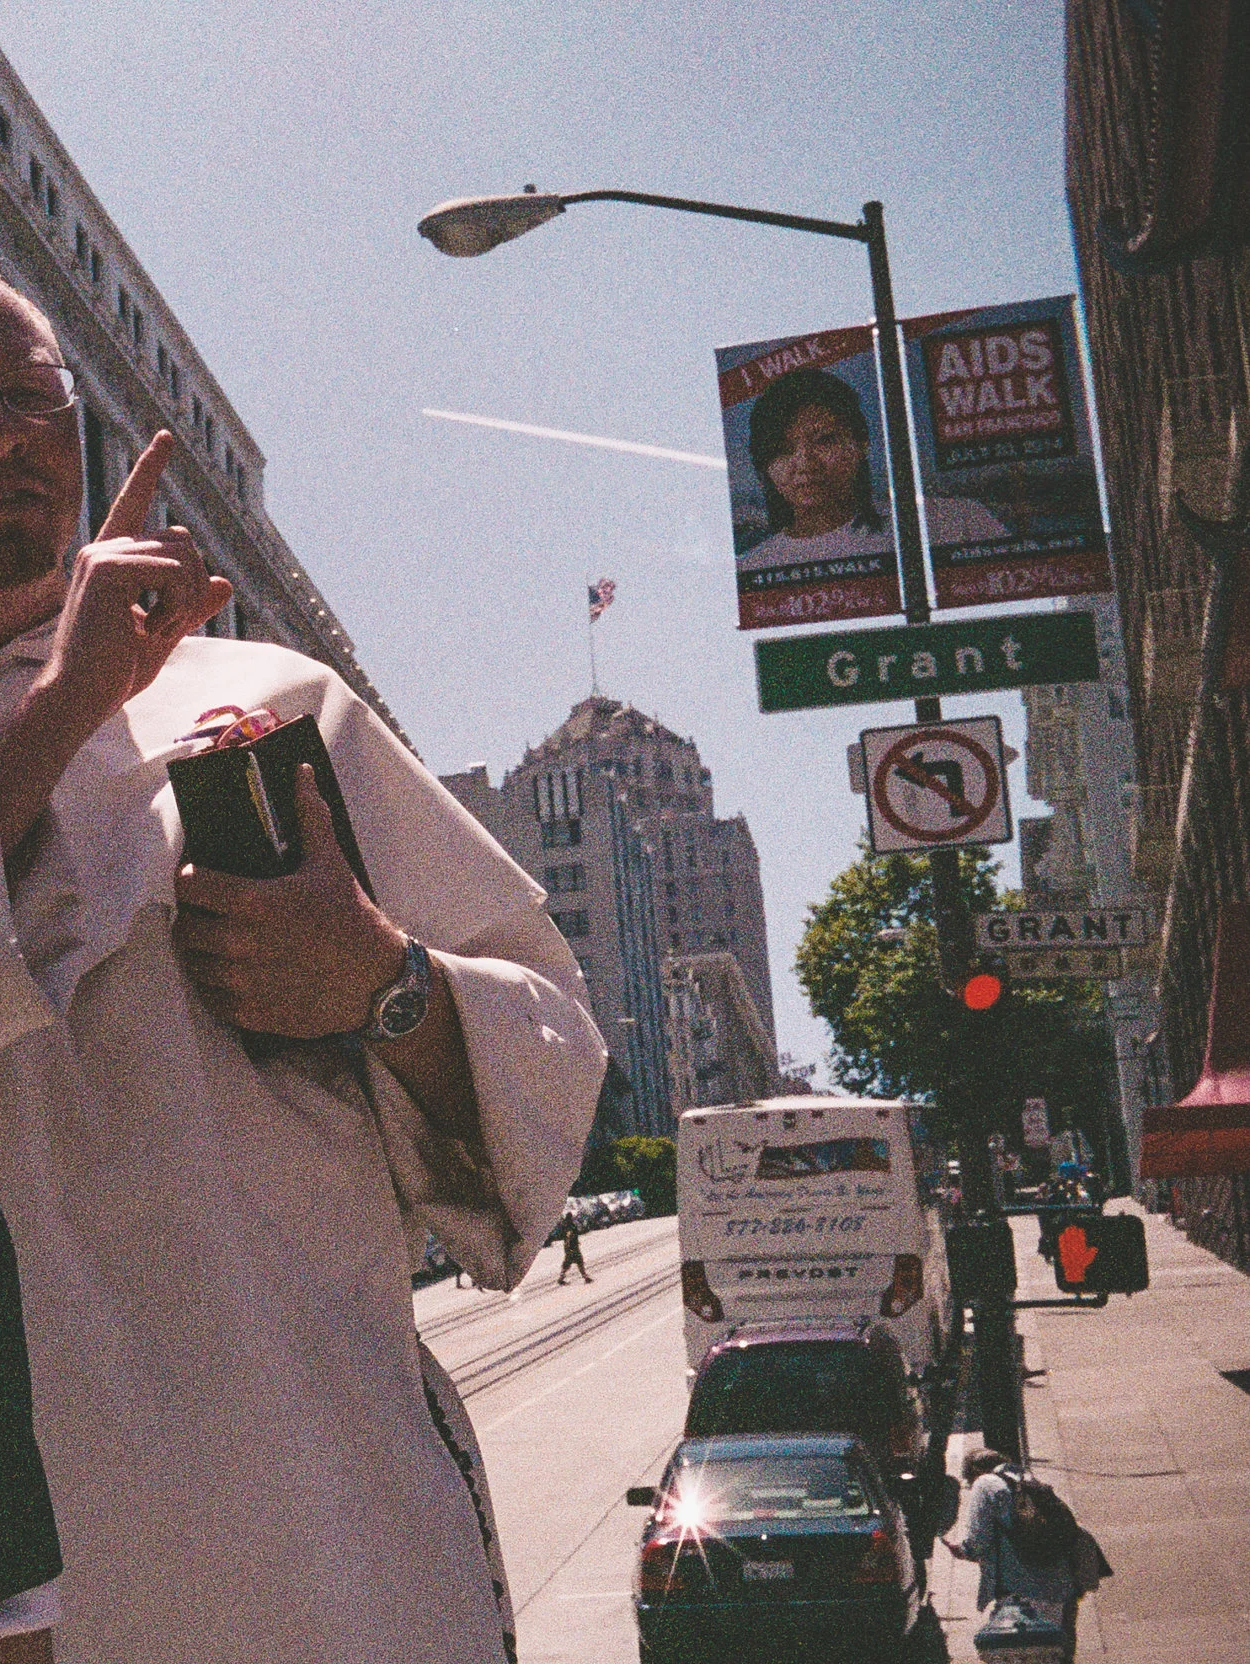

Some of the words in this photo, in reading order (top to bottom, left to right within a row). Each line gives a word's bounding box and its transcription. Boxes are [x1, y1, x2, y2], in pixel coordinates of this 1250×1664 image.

[740, 367, 752, 388] I
[936, 330, 1053, 382] AIDS
[937, 373, 1059, 417] WALK
[826, 634, 1024, 688] Grant
[987, 913, 1132, 943] GRANT
